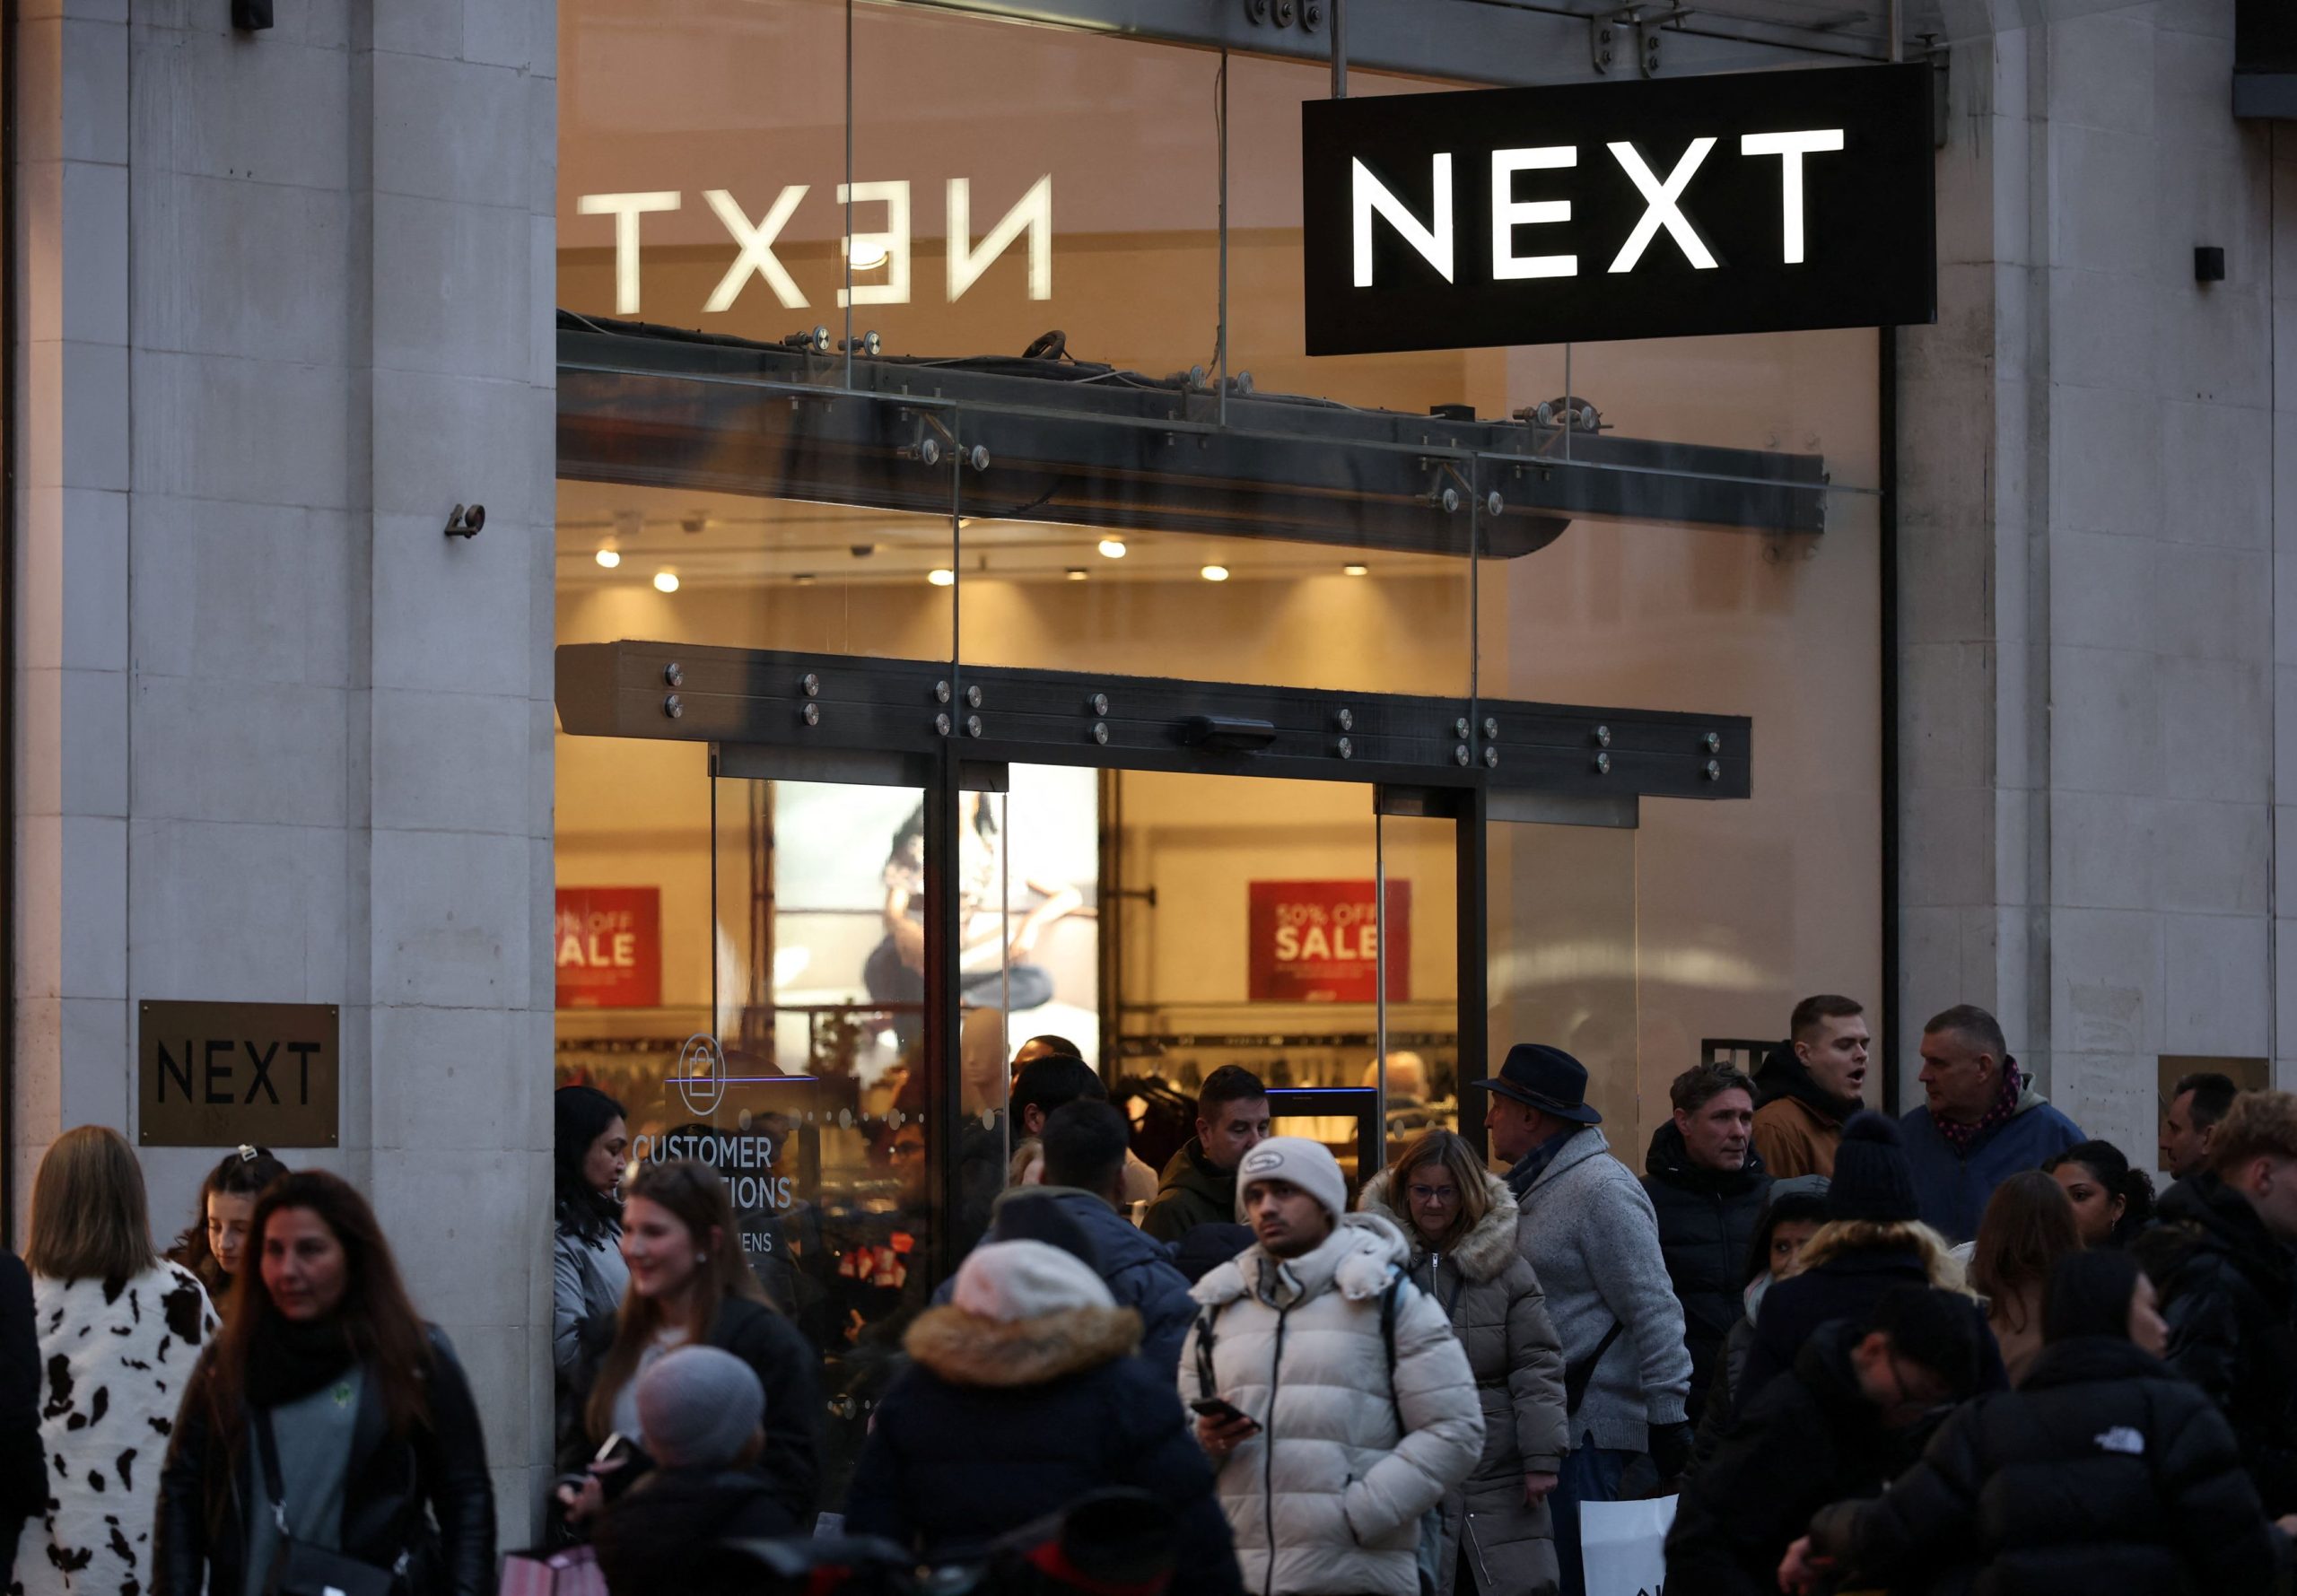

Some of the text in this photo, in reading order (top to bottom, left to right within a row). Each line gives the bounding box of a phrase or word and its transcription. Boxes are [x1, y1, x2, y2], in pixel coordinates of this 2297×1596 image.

[1352, 128, 1844, 287] NEXT
[556, 933, 634, 967] ALE
[1276, 925, 1378, 961] SALE
[158, 1039, 321, 1105] NEXT
[632, 1134, 772, 1168] CUSTOMER
